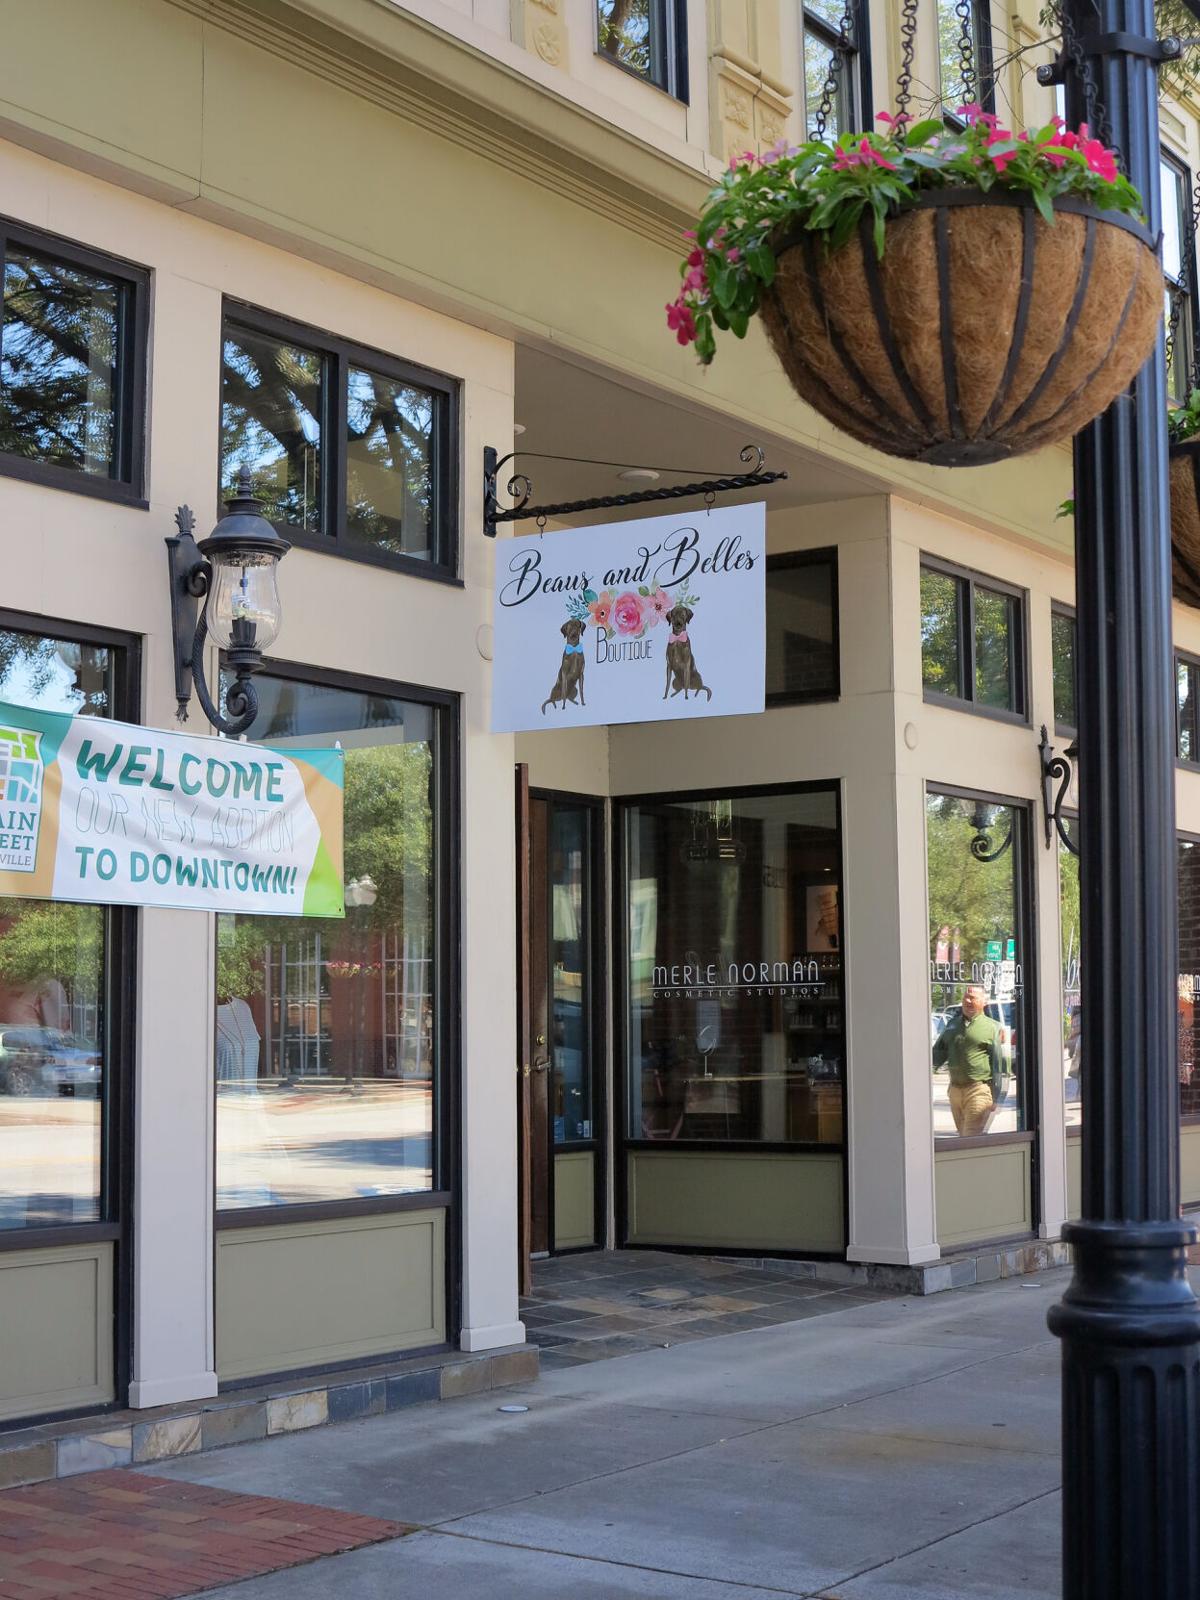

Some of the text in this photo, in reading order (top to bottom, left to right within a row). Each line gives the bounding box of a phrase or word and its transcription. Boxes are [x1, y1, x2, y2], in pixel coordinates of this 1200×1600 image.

[499, 527, 759, 607] Beaus and Belles
[596, 627, 653, 664] BOUTIQUE
[76, 740, 284, 803] WELCOME
[75, 786, 294, 853] OUR NEW ADDITION
[75, 847, 298, 895] TO DOWNTOWN!
[652, 960, 819, 986] MERLE NORMAN
[653, 987, 819, 999] COSMETIC STUDIOS
